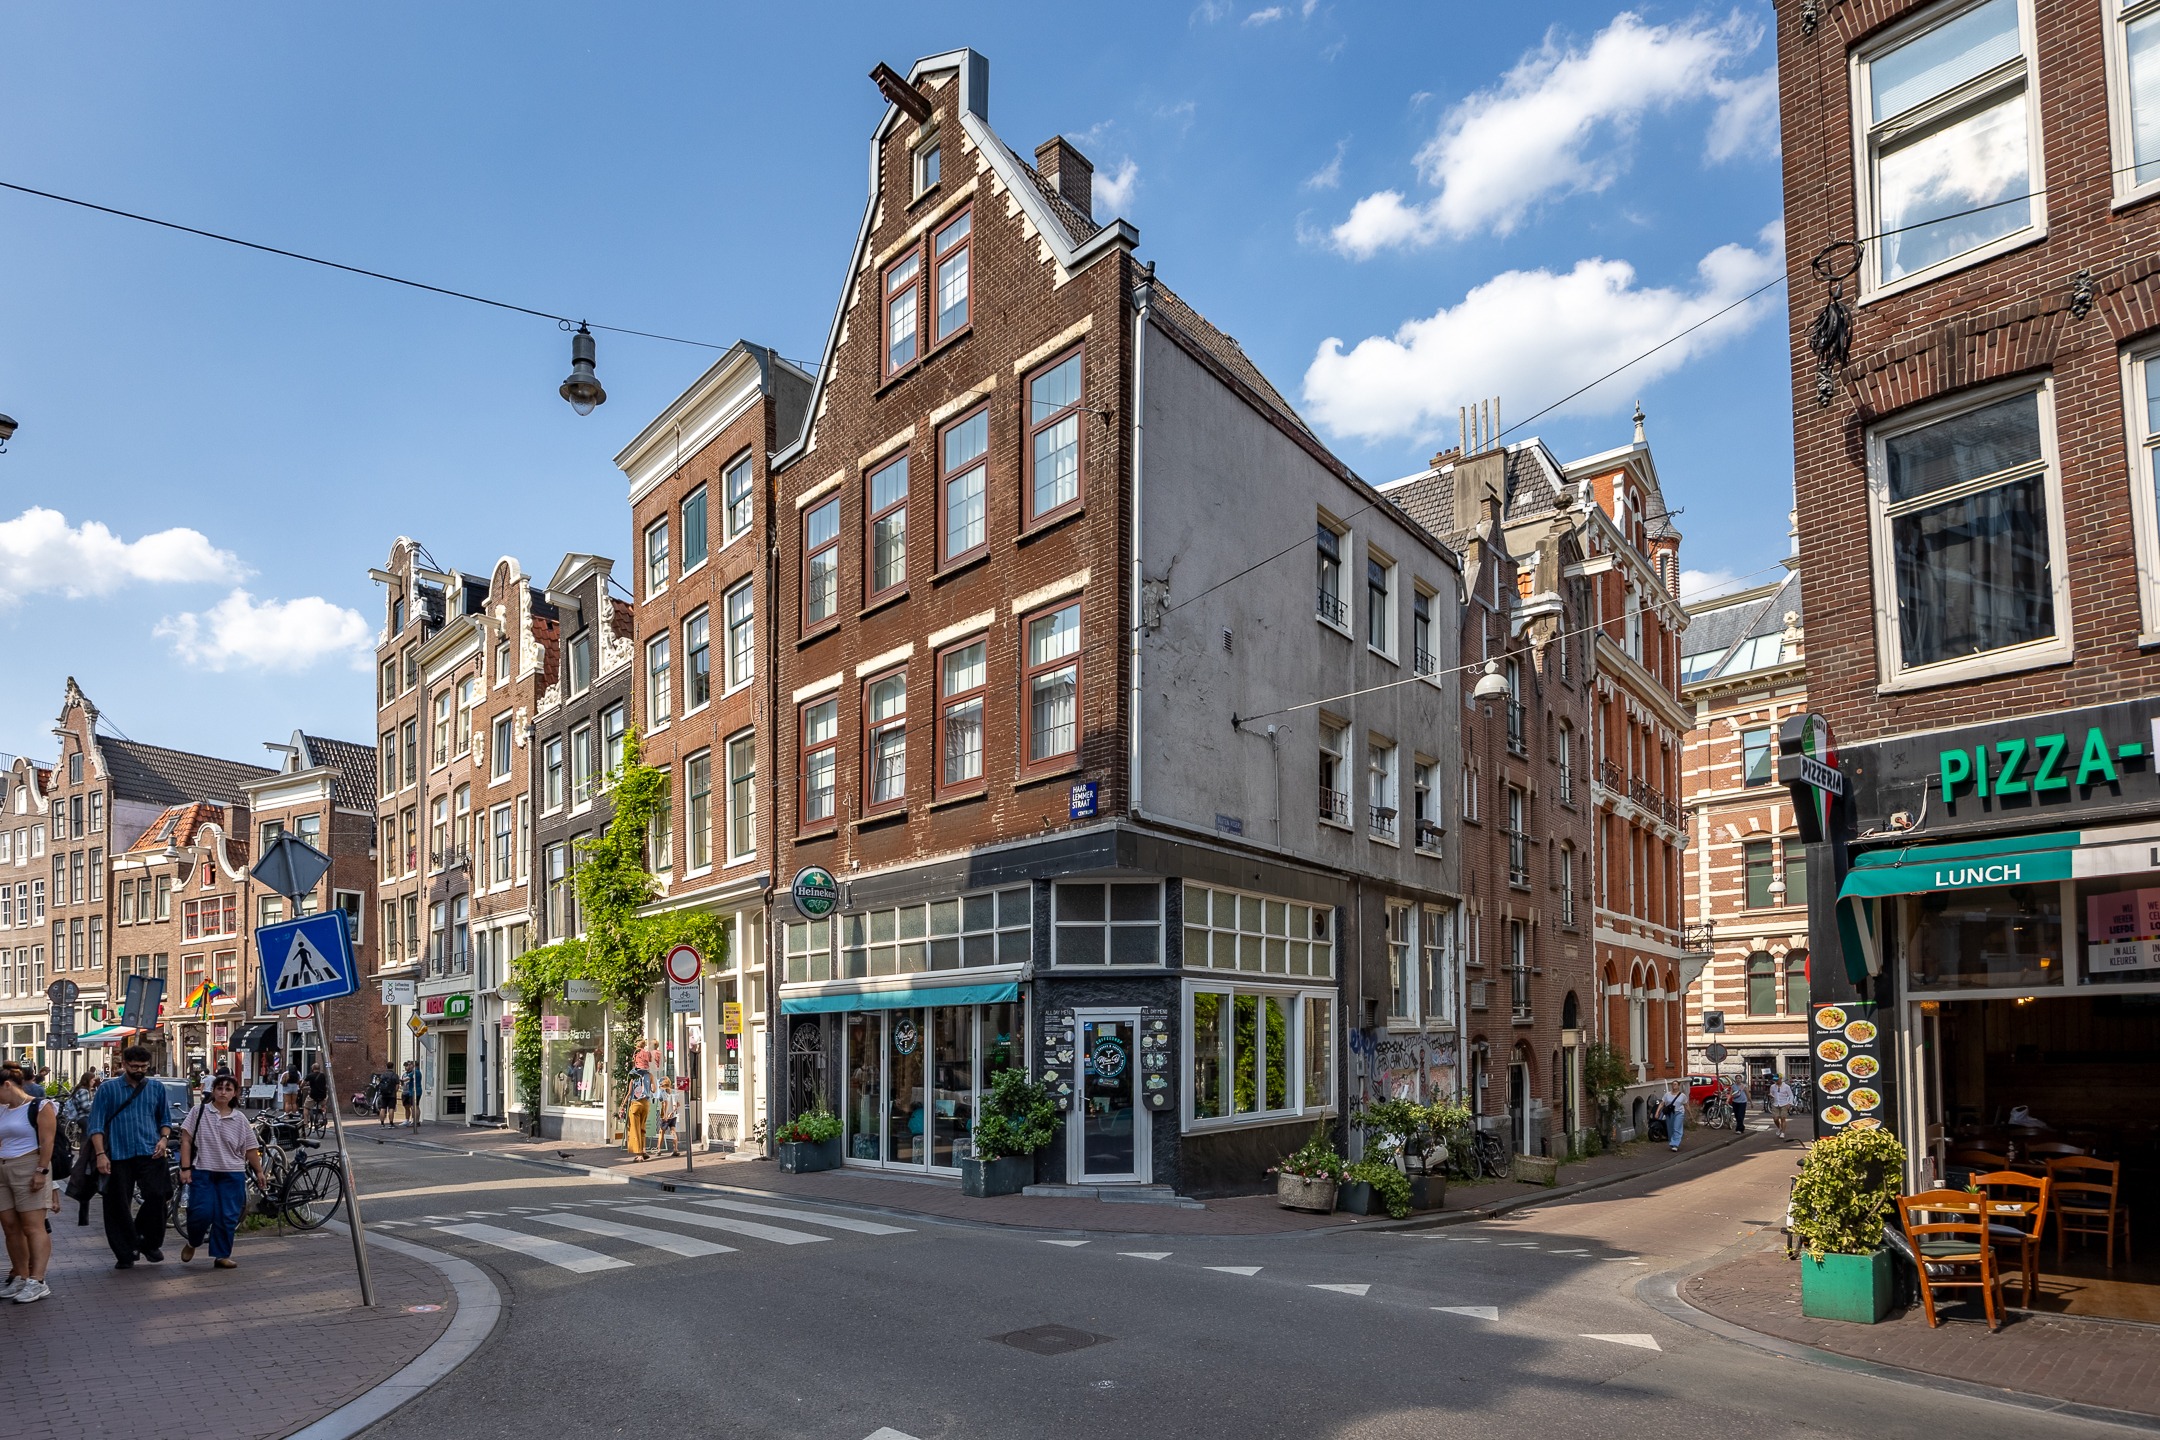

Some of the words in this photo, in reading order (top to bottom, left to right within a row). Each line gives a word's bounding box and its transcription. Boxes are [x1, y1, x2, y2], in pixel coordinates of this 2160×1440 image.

[1939, 727, 2143, 803] PIZZA-
[1801, 759, 1841, 792] PIZZERIA
[1072, 784, 1087, 794] HAAR
[1072, 790, 1094, 802] LEMMER
[1072, 799, 1090, 809] STRAAT
[1935, 863, 2021, 887] LUNCH
[798, 887, 835, 898] Heineken
[2109, 924, 2134, 934] LIEFDE
[2114, 947, 2121, 956] IN
[2122, 945, 2136, 955] ALLE
[2109, 956, 2137, 966] KLEUREN
